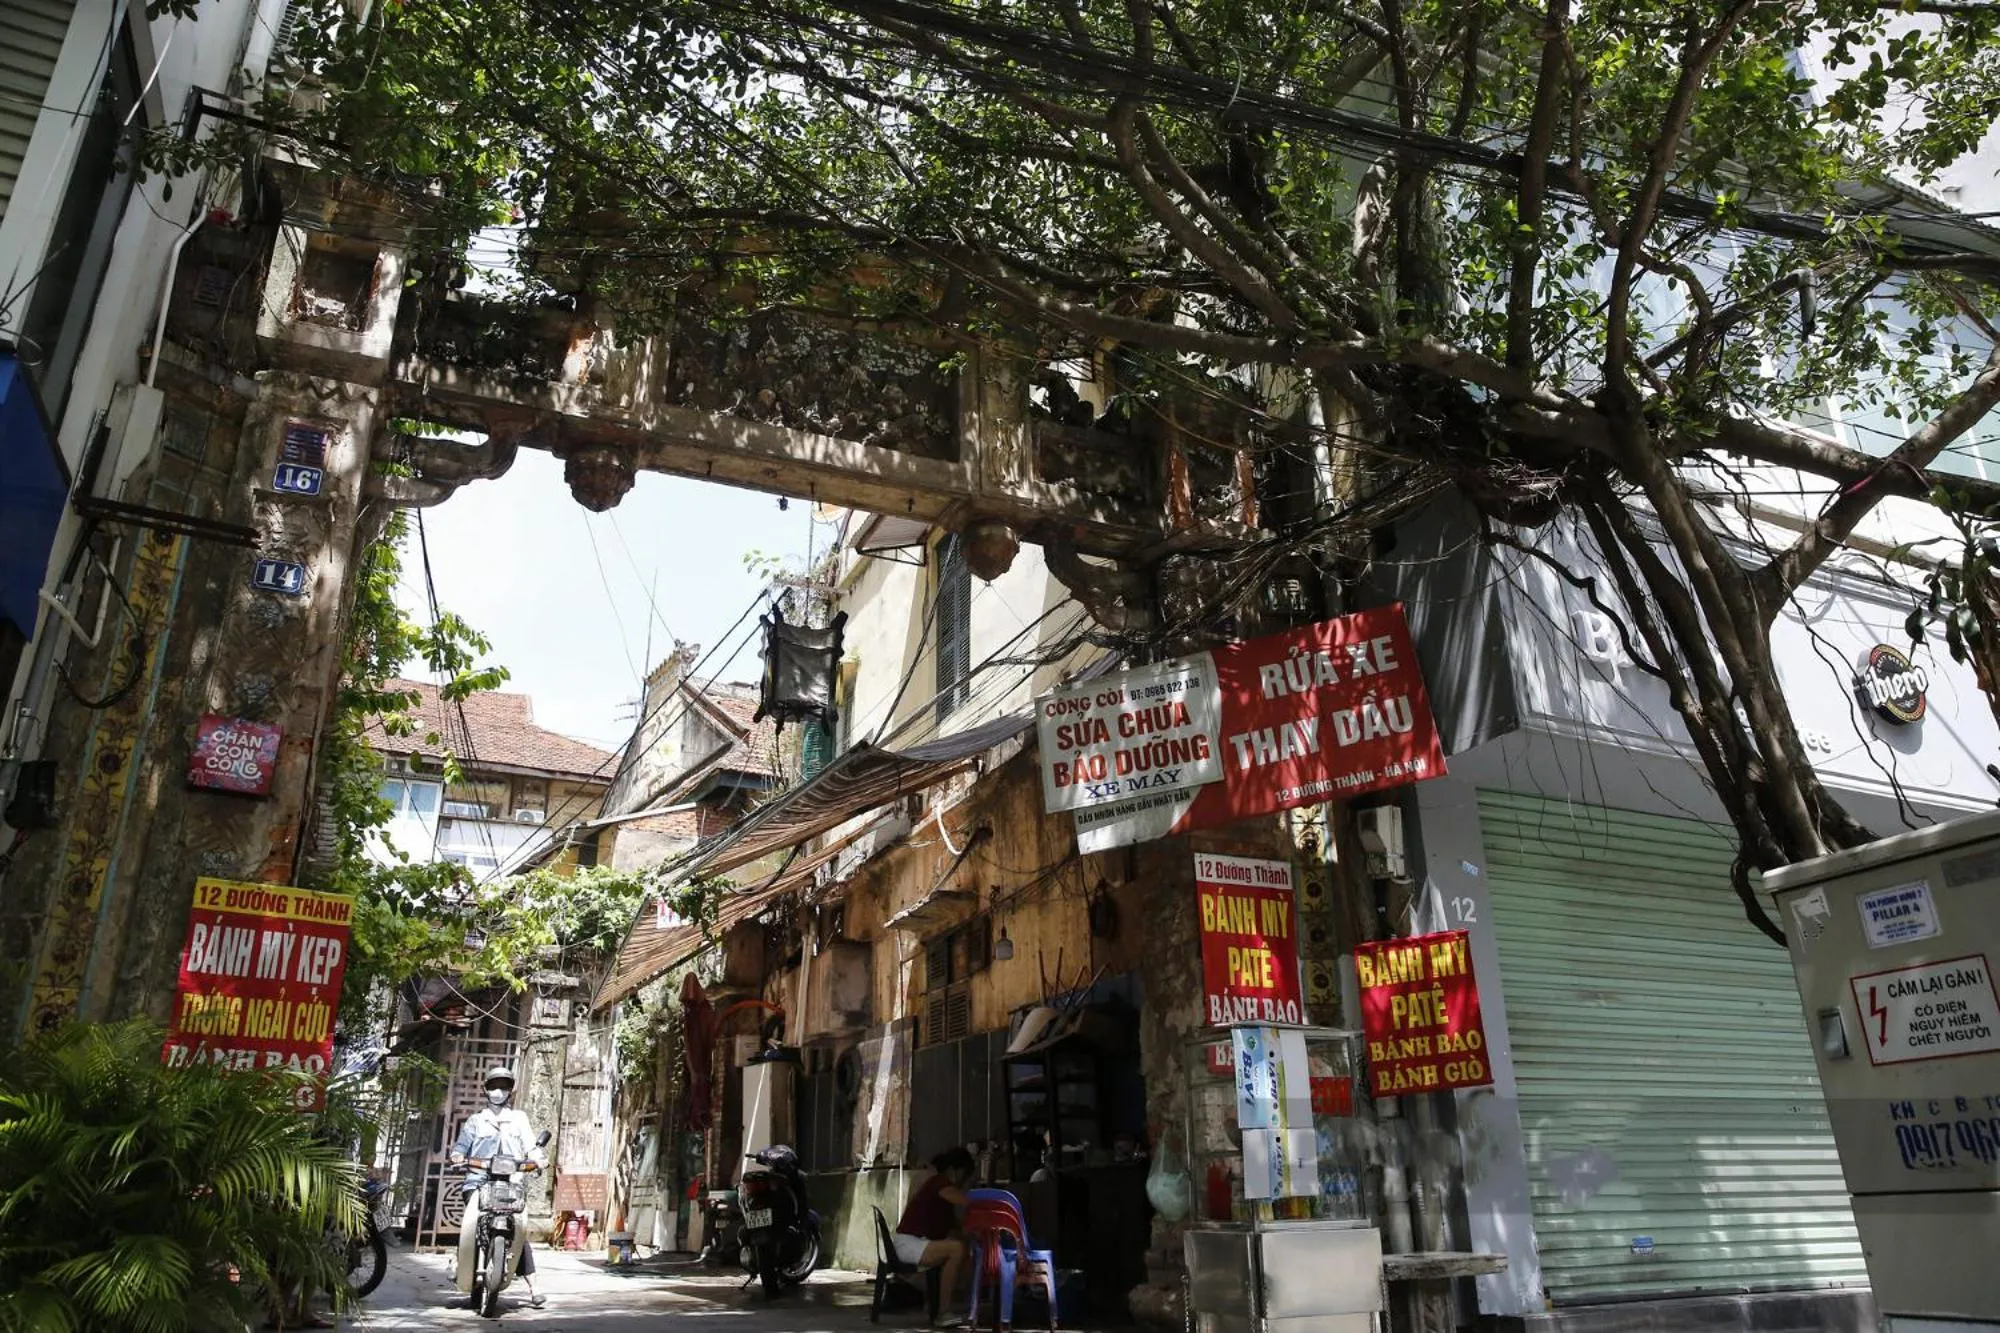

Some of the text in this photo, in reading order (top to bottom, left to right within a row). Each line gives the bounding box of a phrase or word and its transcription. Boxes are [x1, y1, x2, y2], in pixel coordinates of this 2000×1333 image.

[258, 564, 299, 588] 14
[1259, 635, 1399, 700] RỬA XE
[1057, 697, 1192, 750] SỬA CHỮA
[1229, 689, 1414, 770] THAY DẦU
[216, 744, 255, 761] CON
[1053, 734, 1210, 788] BẢO DƯỠNG
[1085, 768, 1182, 799] XE MÁY
[1275, 789, 1289, 802] 12
[1384, 761, 1402, 778] HÀ
[1199, 860, 1213, 878] 12
[1216, 862, 1252, 883] Đường
[200, 886, 350, 921] 12 ĐƯỜNG THÀNH
[1202, 887, 1289, 939] BÁNH MỲ
[1451, 896, 1477, 923] 12
[1872, 904, 1911, 922] PILLAR
[187, 915, 341, 995] BÁNH MỲ KẸP
[1227, 941, 1274, 989] PATÊ
[1358, 945, 1424, 989] BÁNH
[1920, 975, 1944, 995] LẠI
[179, 986, 242, 1038] TRỨNG
[244, 986, 293, 1040] NGẢI
[1210, 988, 1298, 1024] BÁNH BAO
[1391, 982, 1449, 1030] PATÊ
[1914, 1003, 1933, 1017] CÓ
[1909, 1017, 1945, 1032] NGUY
[1369, 1029, 1482, 1062] BÁNH BAO
[1377, 1054, 1484, 1091] BÁNH GIÒ
[1955, 1095, 1969, 1113] B
